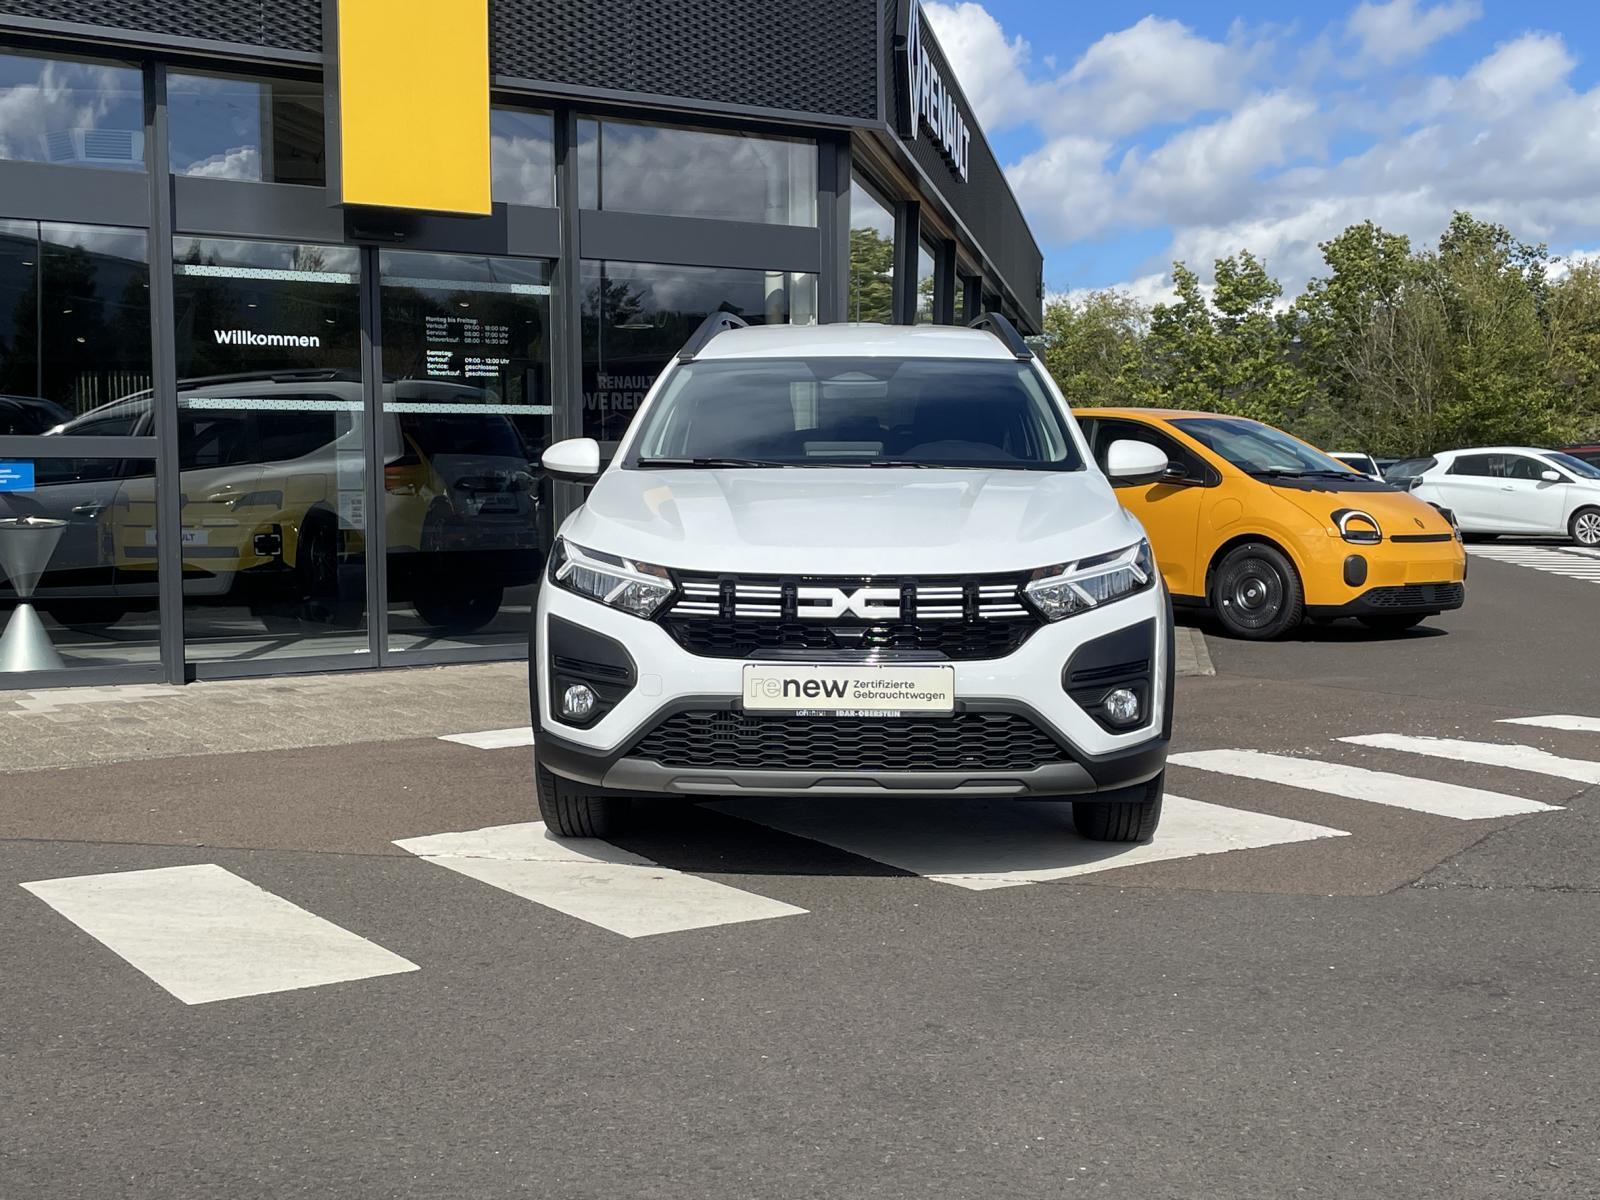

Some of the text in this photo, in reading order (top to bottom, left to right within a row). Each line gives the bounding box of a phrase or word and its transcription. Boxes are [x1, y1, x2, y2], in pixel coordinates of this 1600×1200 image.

[921, 45, 970, 184] RENAULT
[213, 329, 320, 347] Willkommen
[597, 375, 656, 389] RENAULT
[751, 678, 849, 698] renew
[853, 680, 915, 690] Zertifizierte
[853, 690, 946, 701] Gebrauchtwagen
[835, 709, 901, 718] IDAR-OBERSTEIN
